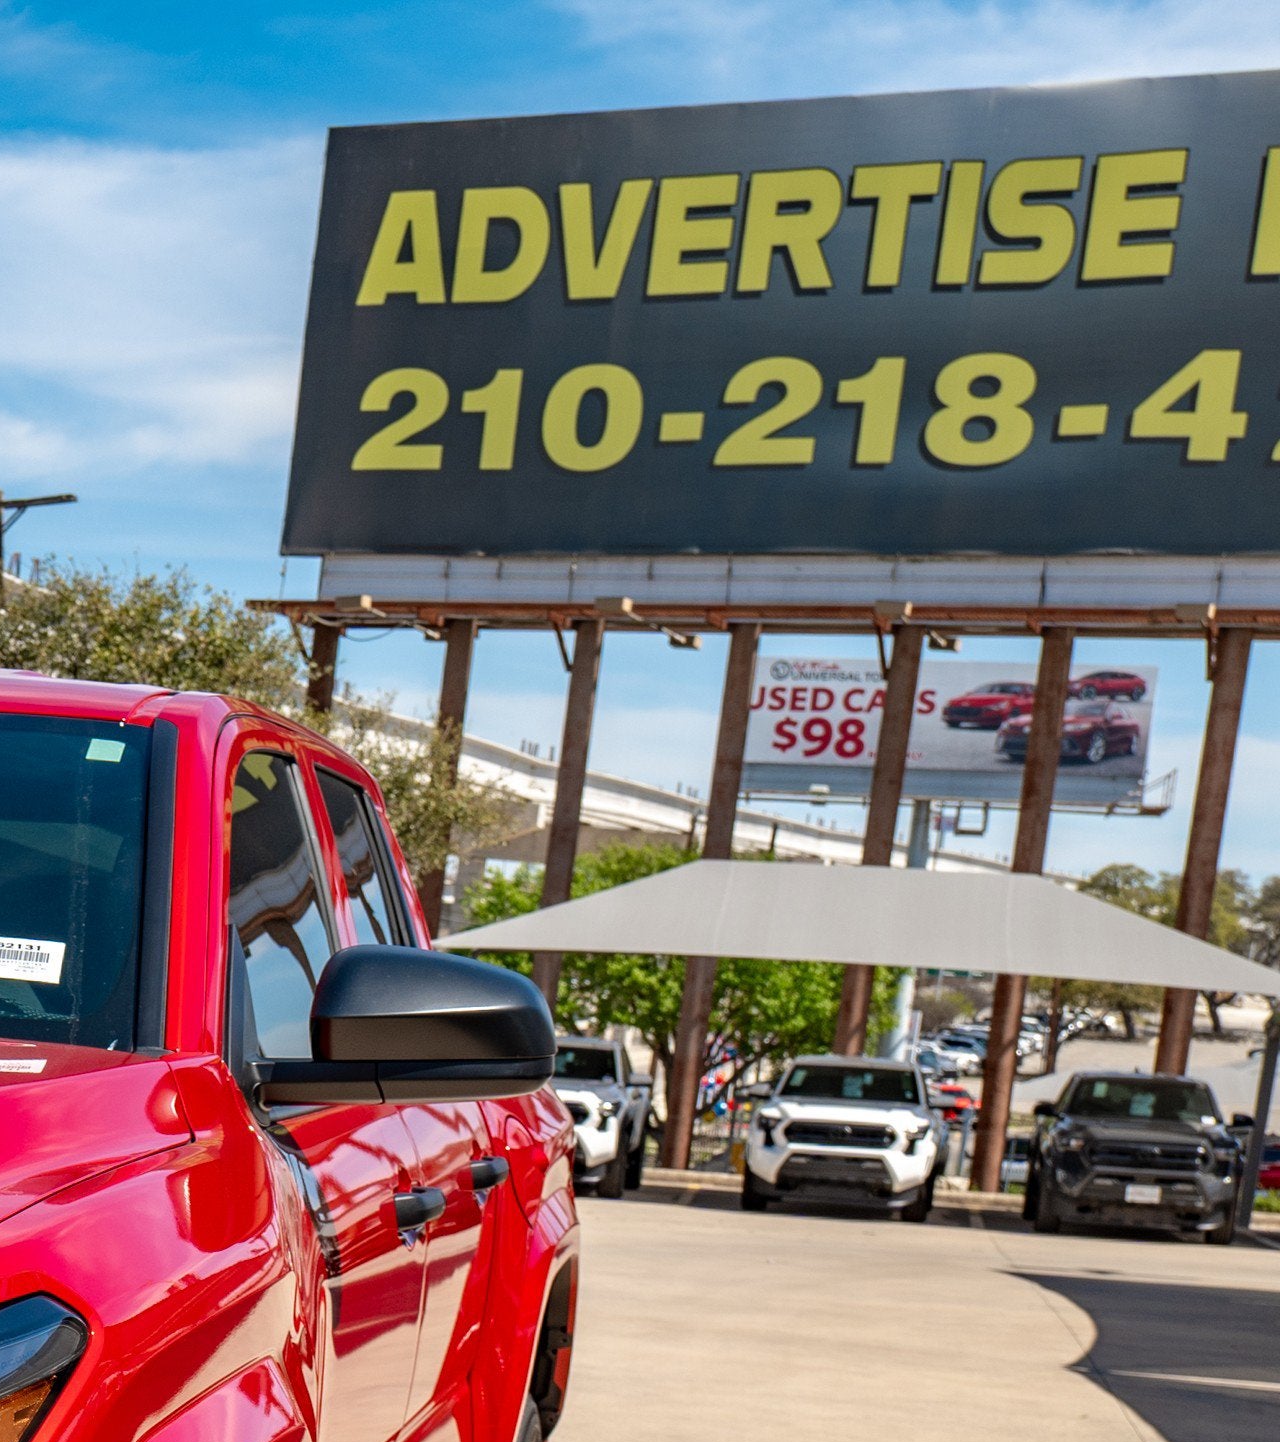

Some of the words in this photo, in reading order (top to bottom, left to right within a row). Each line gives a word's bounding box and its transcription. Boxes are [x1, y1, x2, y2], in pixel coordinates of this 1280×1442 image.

[355, 148, 1190, 307] ADVERTISE
[350, 348, 1280, 473] 210-218-4
[772, 717, 865, 758] $98
[842, 688, 937, 714] CAS
